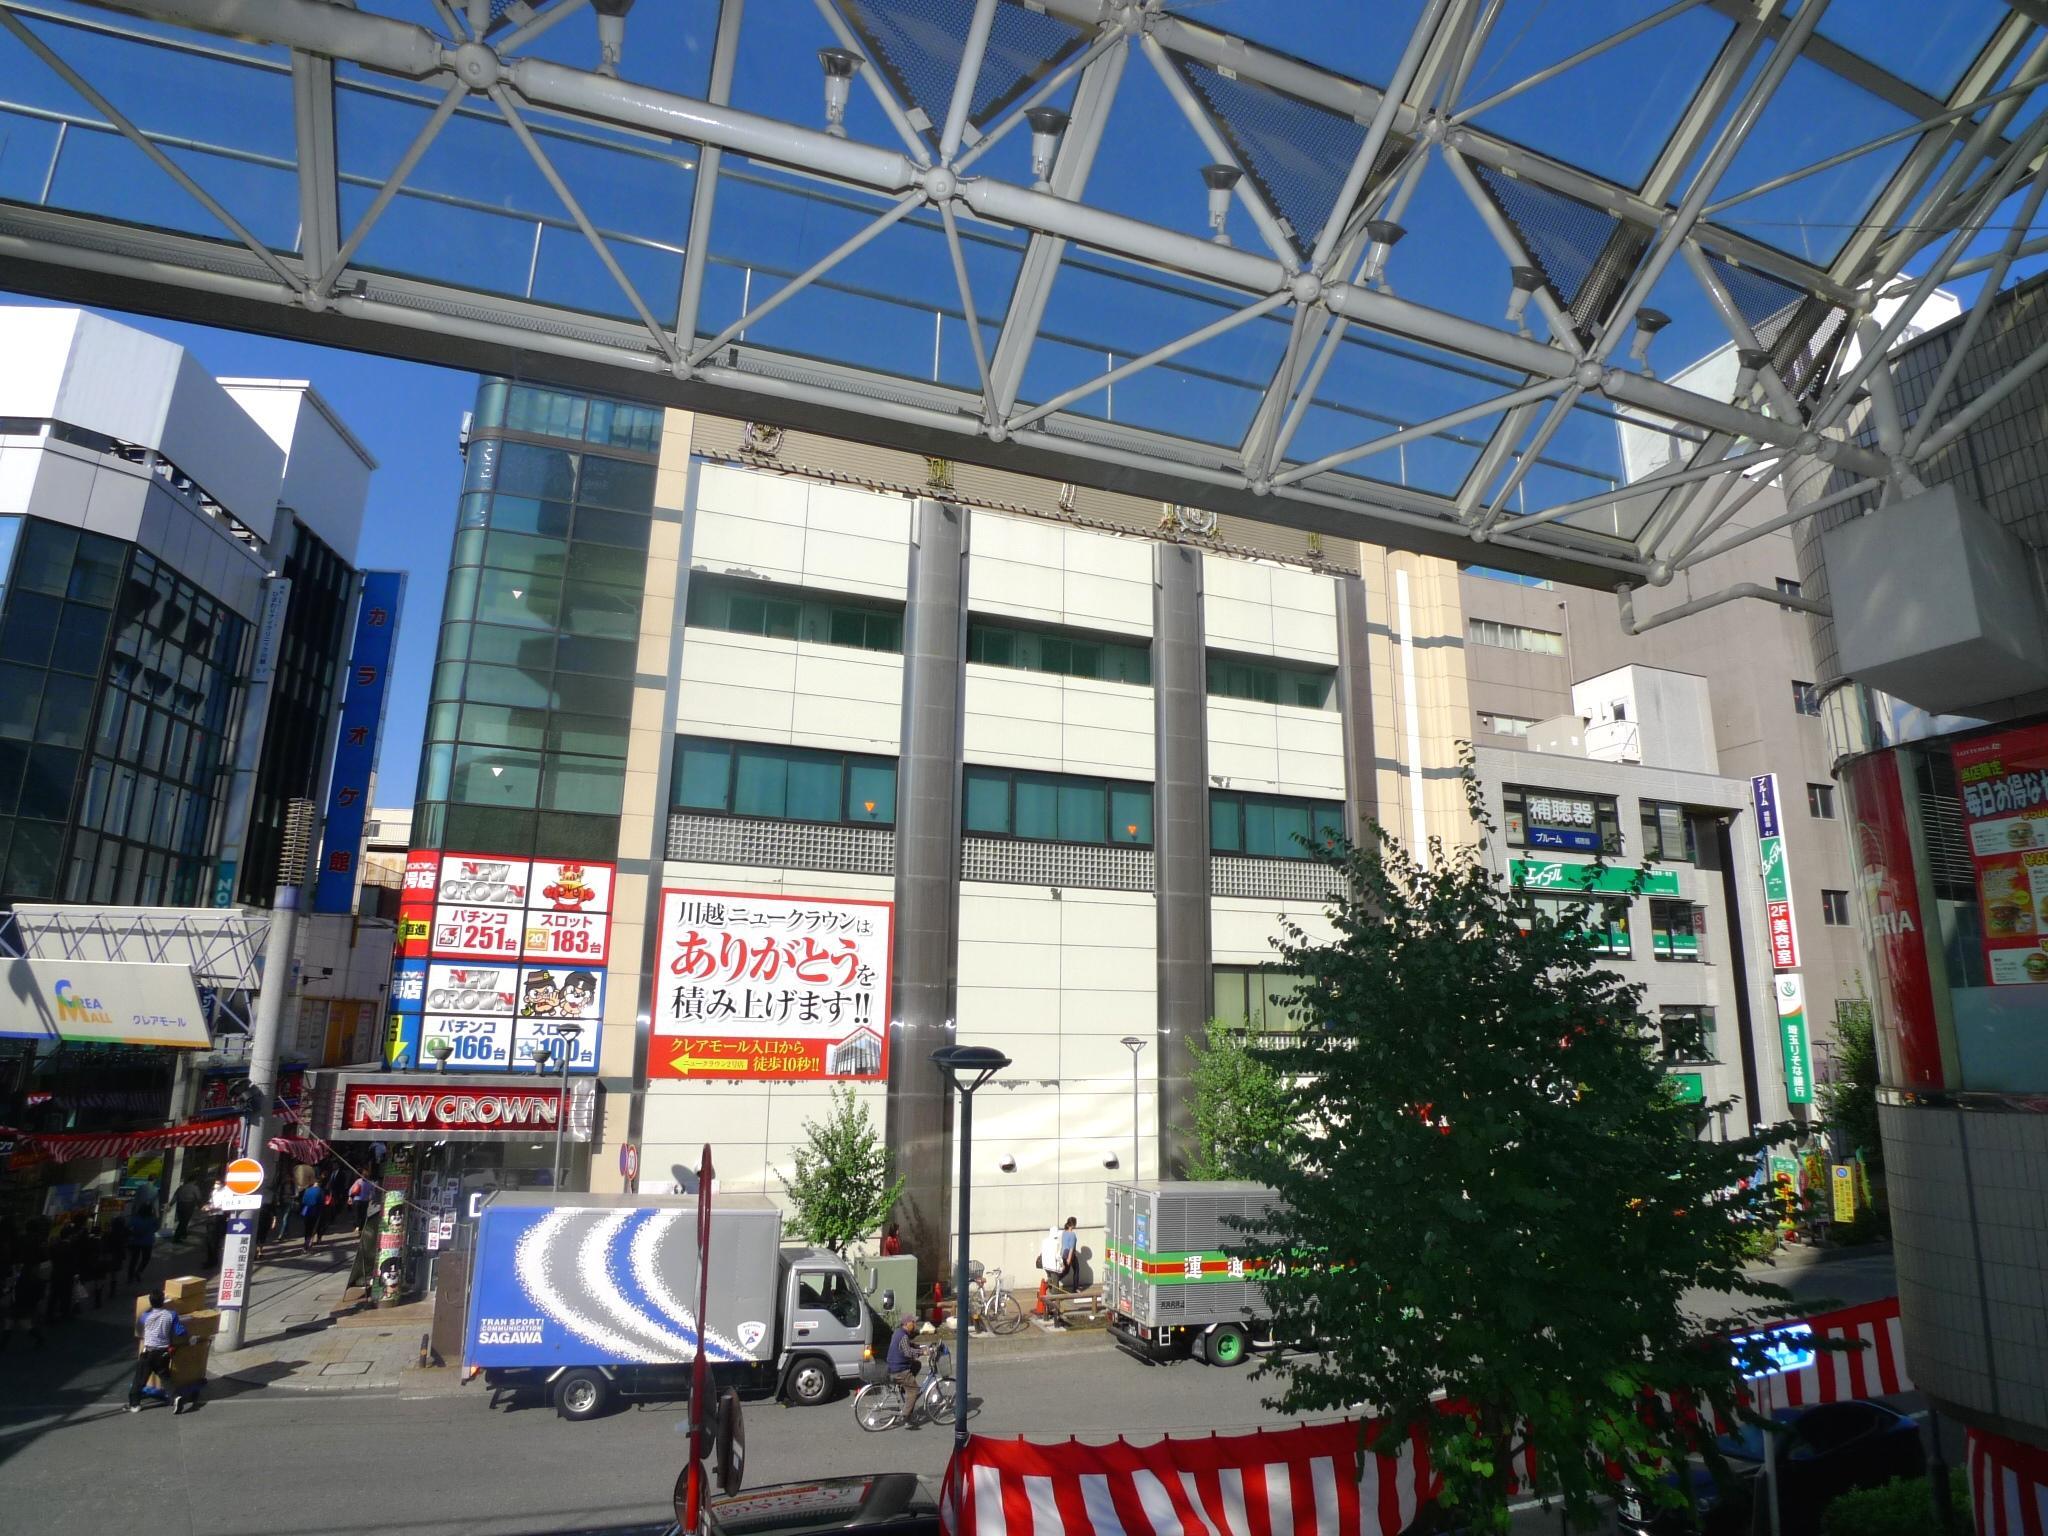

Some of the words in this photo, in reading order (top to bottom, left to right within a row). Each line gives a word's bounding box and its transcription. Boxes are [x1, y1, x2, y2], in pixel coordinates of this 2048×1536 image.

[328, 609, 387, 872] カラオケ館
[1757, 777, 1769, 806] ブルーム
[1530, 797, 1594, 824] 補聴器
[1536, 832, 1563, 844] ブルーム
[460, 861, 511, 882] NEW
[213, 878, 233, 908] NO
[441, 880, 526, 904] CROWN
[452, 908, 508, 924] パチンコ
[541, 914, 593, 928] スロット
[1770, 906, 1787, 917] 2F
[463, 924, 517, 951] 251台
[550, 930, 602, 954] 183台
[1772, 918, 1793, 965] 美容室
[671, 931, 875, 987] ありがとうを
[448, 969, 499, 990] NEW
[428, 988, 514, 1012] CROWN
[671, 986, 873, 1024] 積み上げます!!
[132, 1015, 187, 1027] クレアモール
[439, 1019, 496, 1034] パチンコ
[671, 1038, 805, 1054] クレアモール入口から
[753, 1056, 819, 1073] 徒歩10秒!!
[1787, 1024, 1805, 1098] 埼玉りそな銀行
[355, 1095, 432, 1124] NEW
[434, 1095, 558, 1125] CROWN
[220, 1268, 235, 1301] 迂回路
[478, 1332, 543, 1344] SAGAWA
